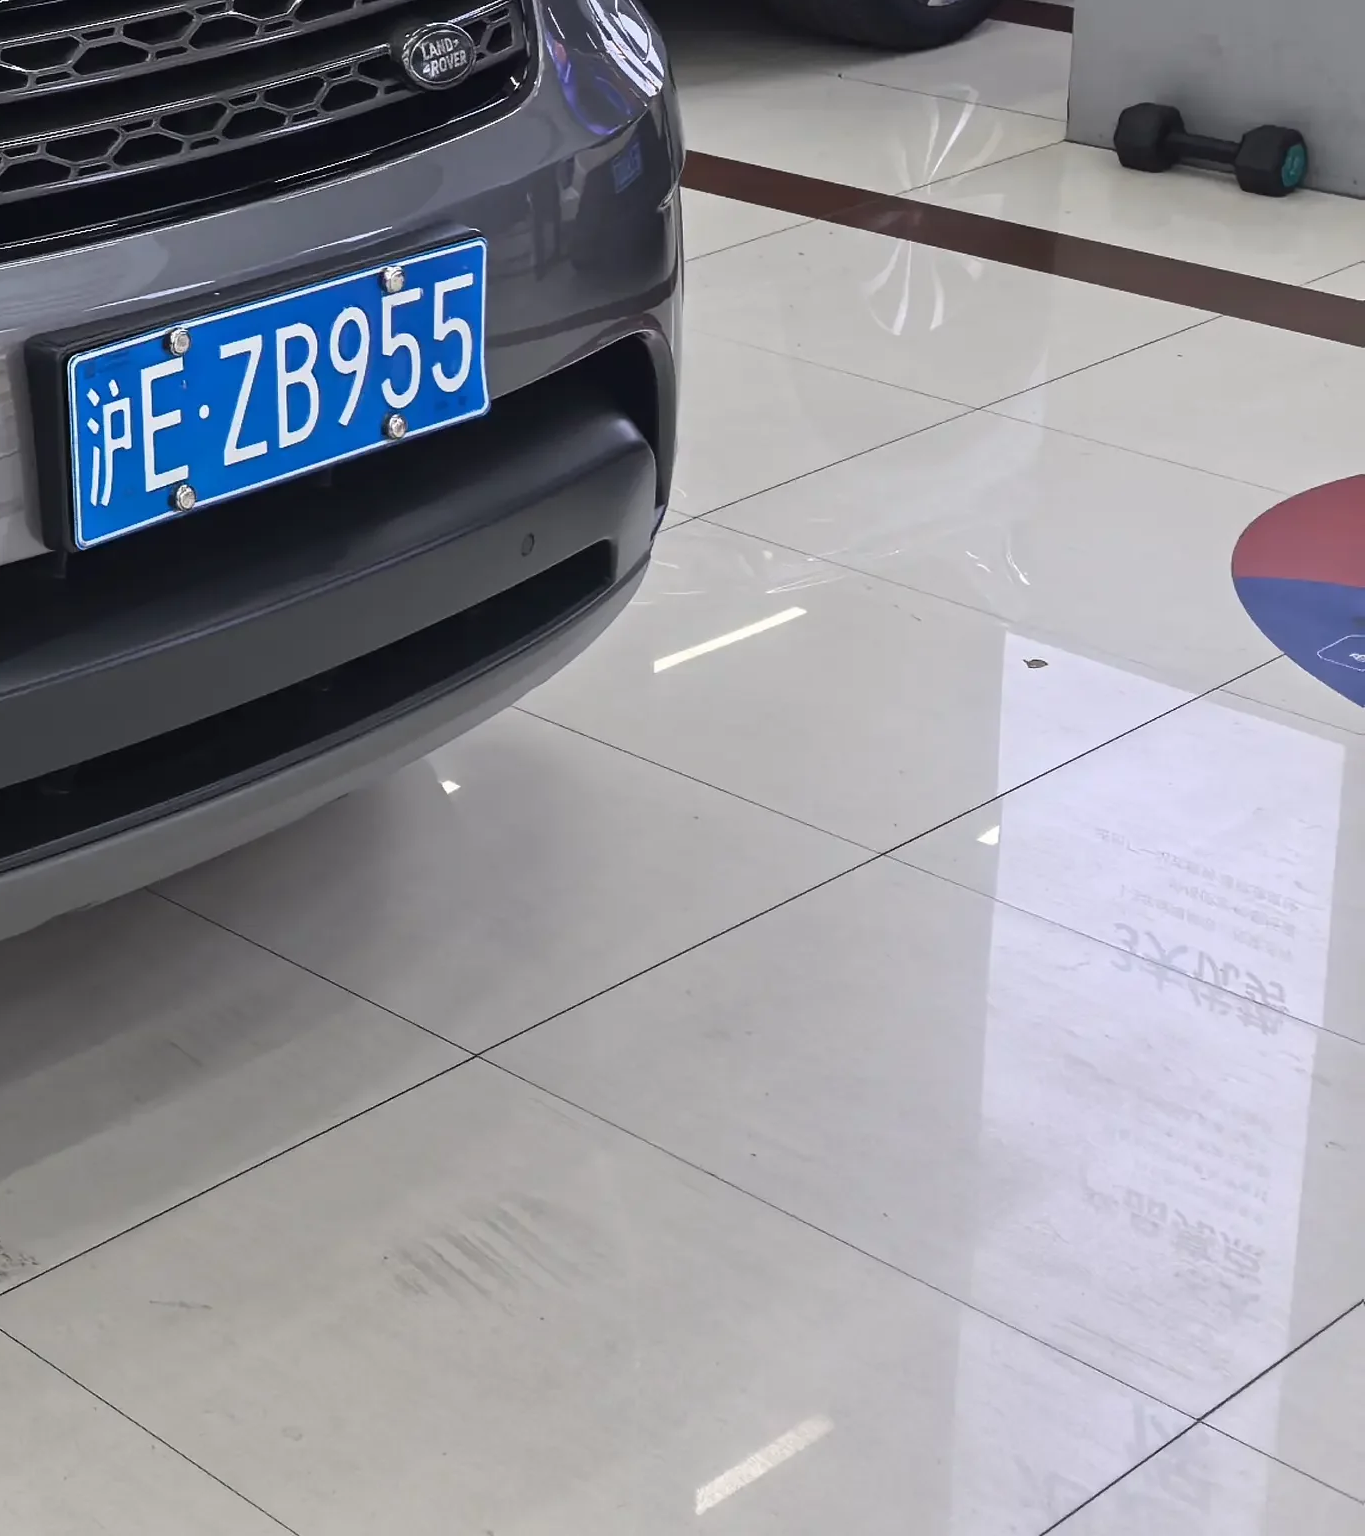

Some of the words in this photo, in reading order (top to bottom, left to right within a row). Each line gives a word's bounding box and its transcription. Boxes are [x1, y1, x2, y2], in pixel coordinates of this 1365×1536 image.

[422, 39, 453, 61] LAND
[431, 49, 468, 77] ROVER
[86, 272, 474, 507] 沪E·ZB955
